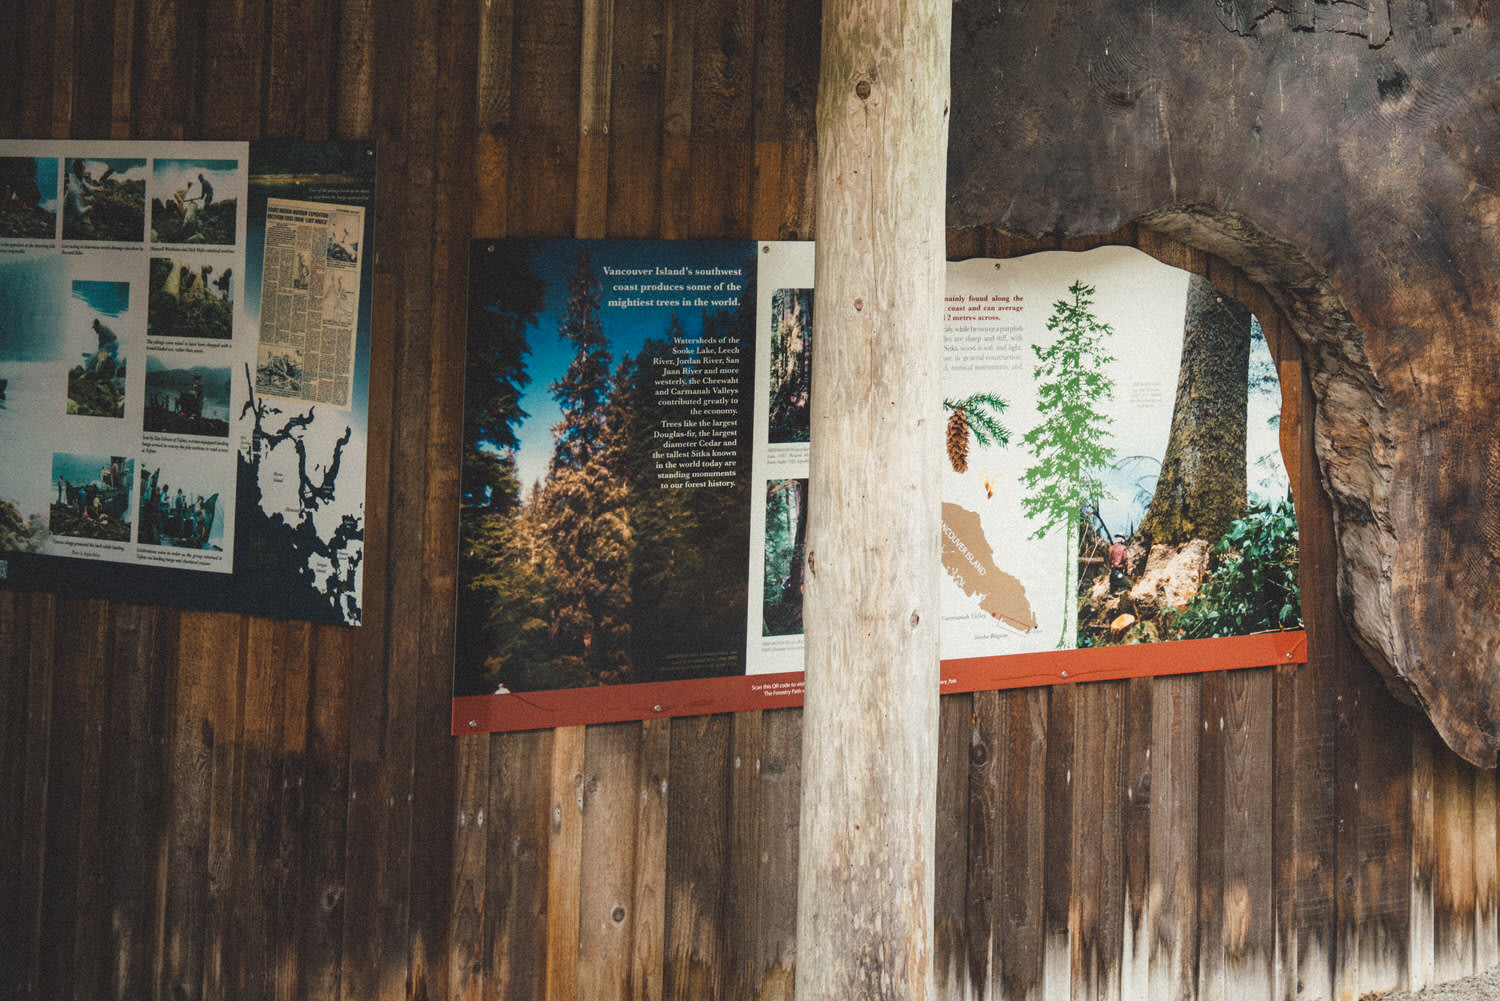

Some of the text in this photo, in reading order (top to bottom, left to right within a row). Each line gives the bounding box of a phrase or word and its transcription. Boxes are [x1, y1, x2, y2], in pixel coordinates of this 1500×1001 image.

[603, 266, 742, 275] Vancouver Island's southwest
[641, 282, 684, 293] produces
[714, 282, 724, 291] of
[727, 282, 742, 291] the
[608, 298, 740, 309] mightiest trees in the world.
[674, 336, 716, 344] Watersheds
[718, 346, 740, 354] Leech
[653, 357, 675, 365] River,
[675, 357, 701, 366] Jordan
[725, 356, 739, 364] San
[662, 368, 680, 376] Juan
[712, 387, 738, 395] Valleys
[658, 398, 701, 406] contributed
[703, 397, 728, 406] greatly
[703, 408, 738, 417] economy.
[661, 420, 682, 428] Trees
[712, 419, 737, 428] largest
[654, 430, 697, 439] Douglas-fir,
[712, 429, 737, 438] largest
[652, 451, 664, 459] the
[656, 461, 663, 469] in
[702, 460, 723, 468] today
[657, 471, 690, 480] standing
[685, 480, 706, 488] forest
[708, 480, 736, 488] history.
[965, 552, 986, 576] ISLAND
